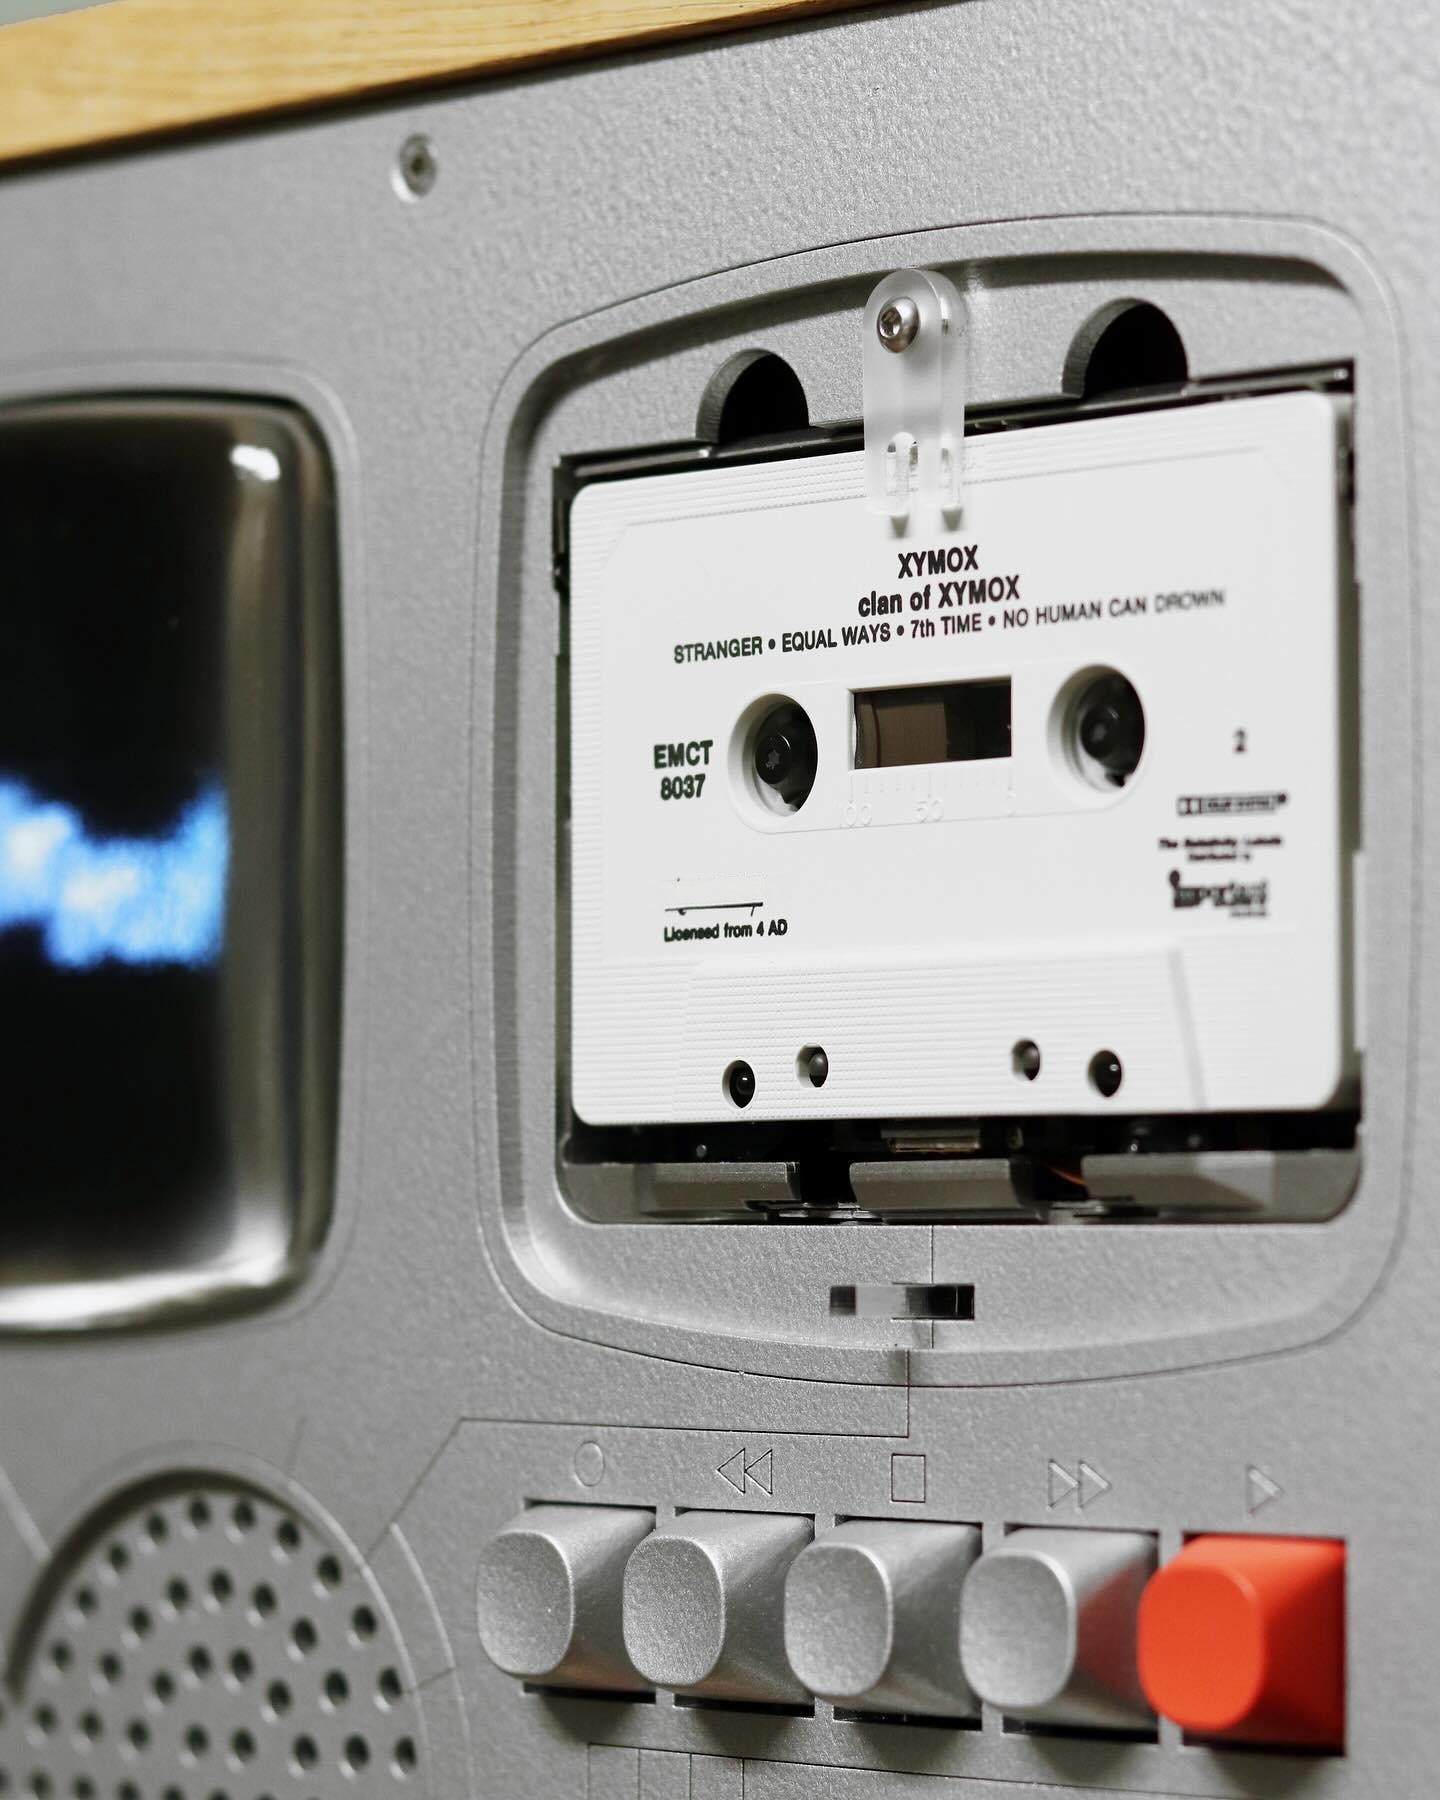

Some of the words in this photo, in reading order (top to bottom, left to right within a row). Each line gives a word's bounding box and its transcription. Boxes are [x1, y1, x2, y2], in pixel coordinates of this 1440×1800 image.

[897, 544, 979, 579] XYMOX
[857, 590, 903, 618] clan
[909, 584, 932, 612] of
[937, 574, 1021, 609] XYMOX
[673, 636, 764, 665] STRANGER
[781, 628, 838, 653] EQUAL
[841, 622, 892, 647] WAYS
[910, 619, 935, 639] 7th
[940, 612, 983, 636] TIME
[1003, 608, 1029, 629] NO
[1035, 598, 1103, 626] HUMAN
[1107, 596, 1147, 618] CAN
[653, 739, 714, 770] EMCT
[660, 772, 707, 802] 8037
[663, 922, 720, 944] Licensed
[723, 921, 753, 940] from
[756, 920, 765, 937] 4
[767, 918, 789, 937] AD
